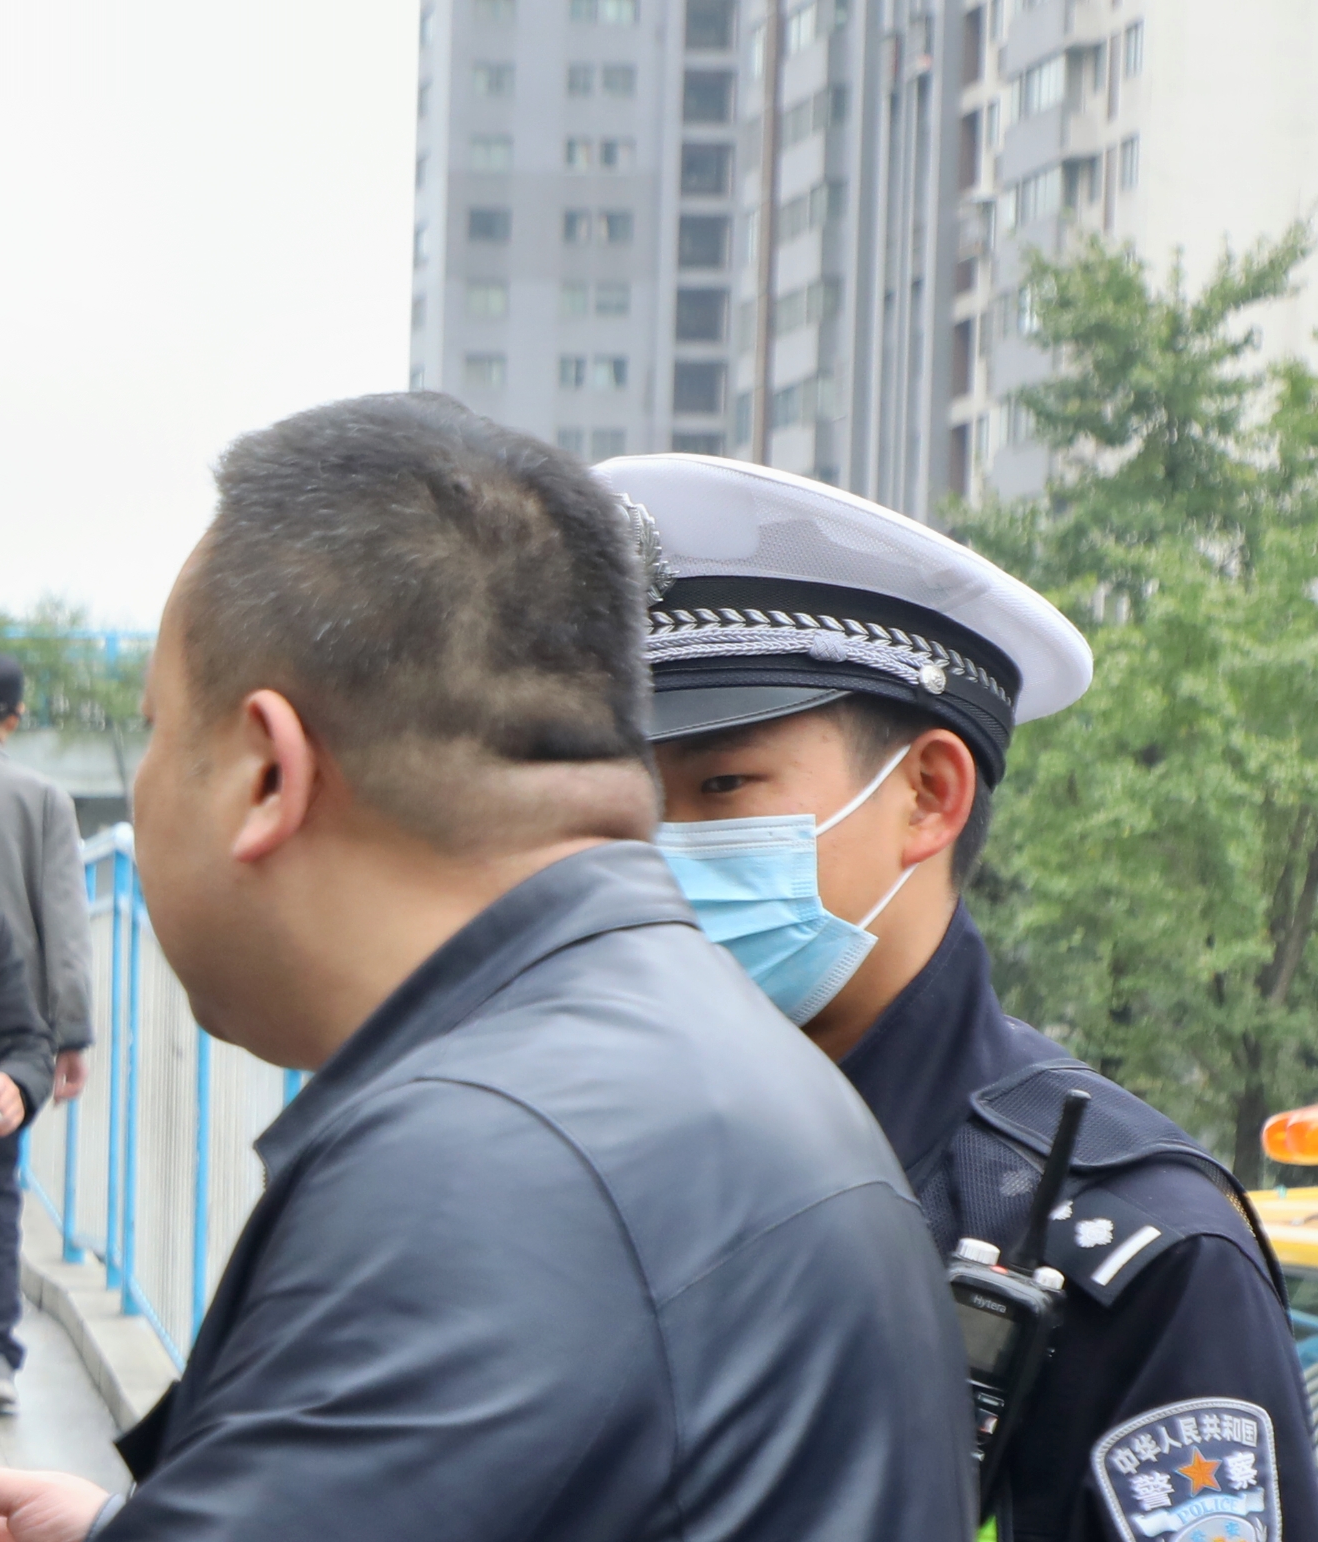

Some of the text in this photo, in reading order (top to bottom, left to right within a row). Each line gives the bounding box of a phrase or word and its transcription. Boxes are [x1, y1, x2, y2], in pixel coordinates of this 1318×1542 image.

[973, 1294, 1007, 1314] Hytera
[1113, 1414, 1258, 1475] 中华人民共和国
[1176, 1496, 1239, 1525] POLICE
